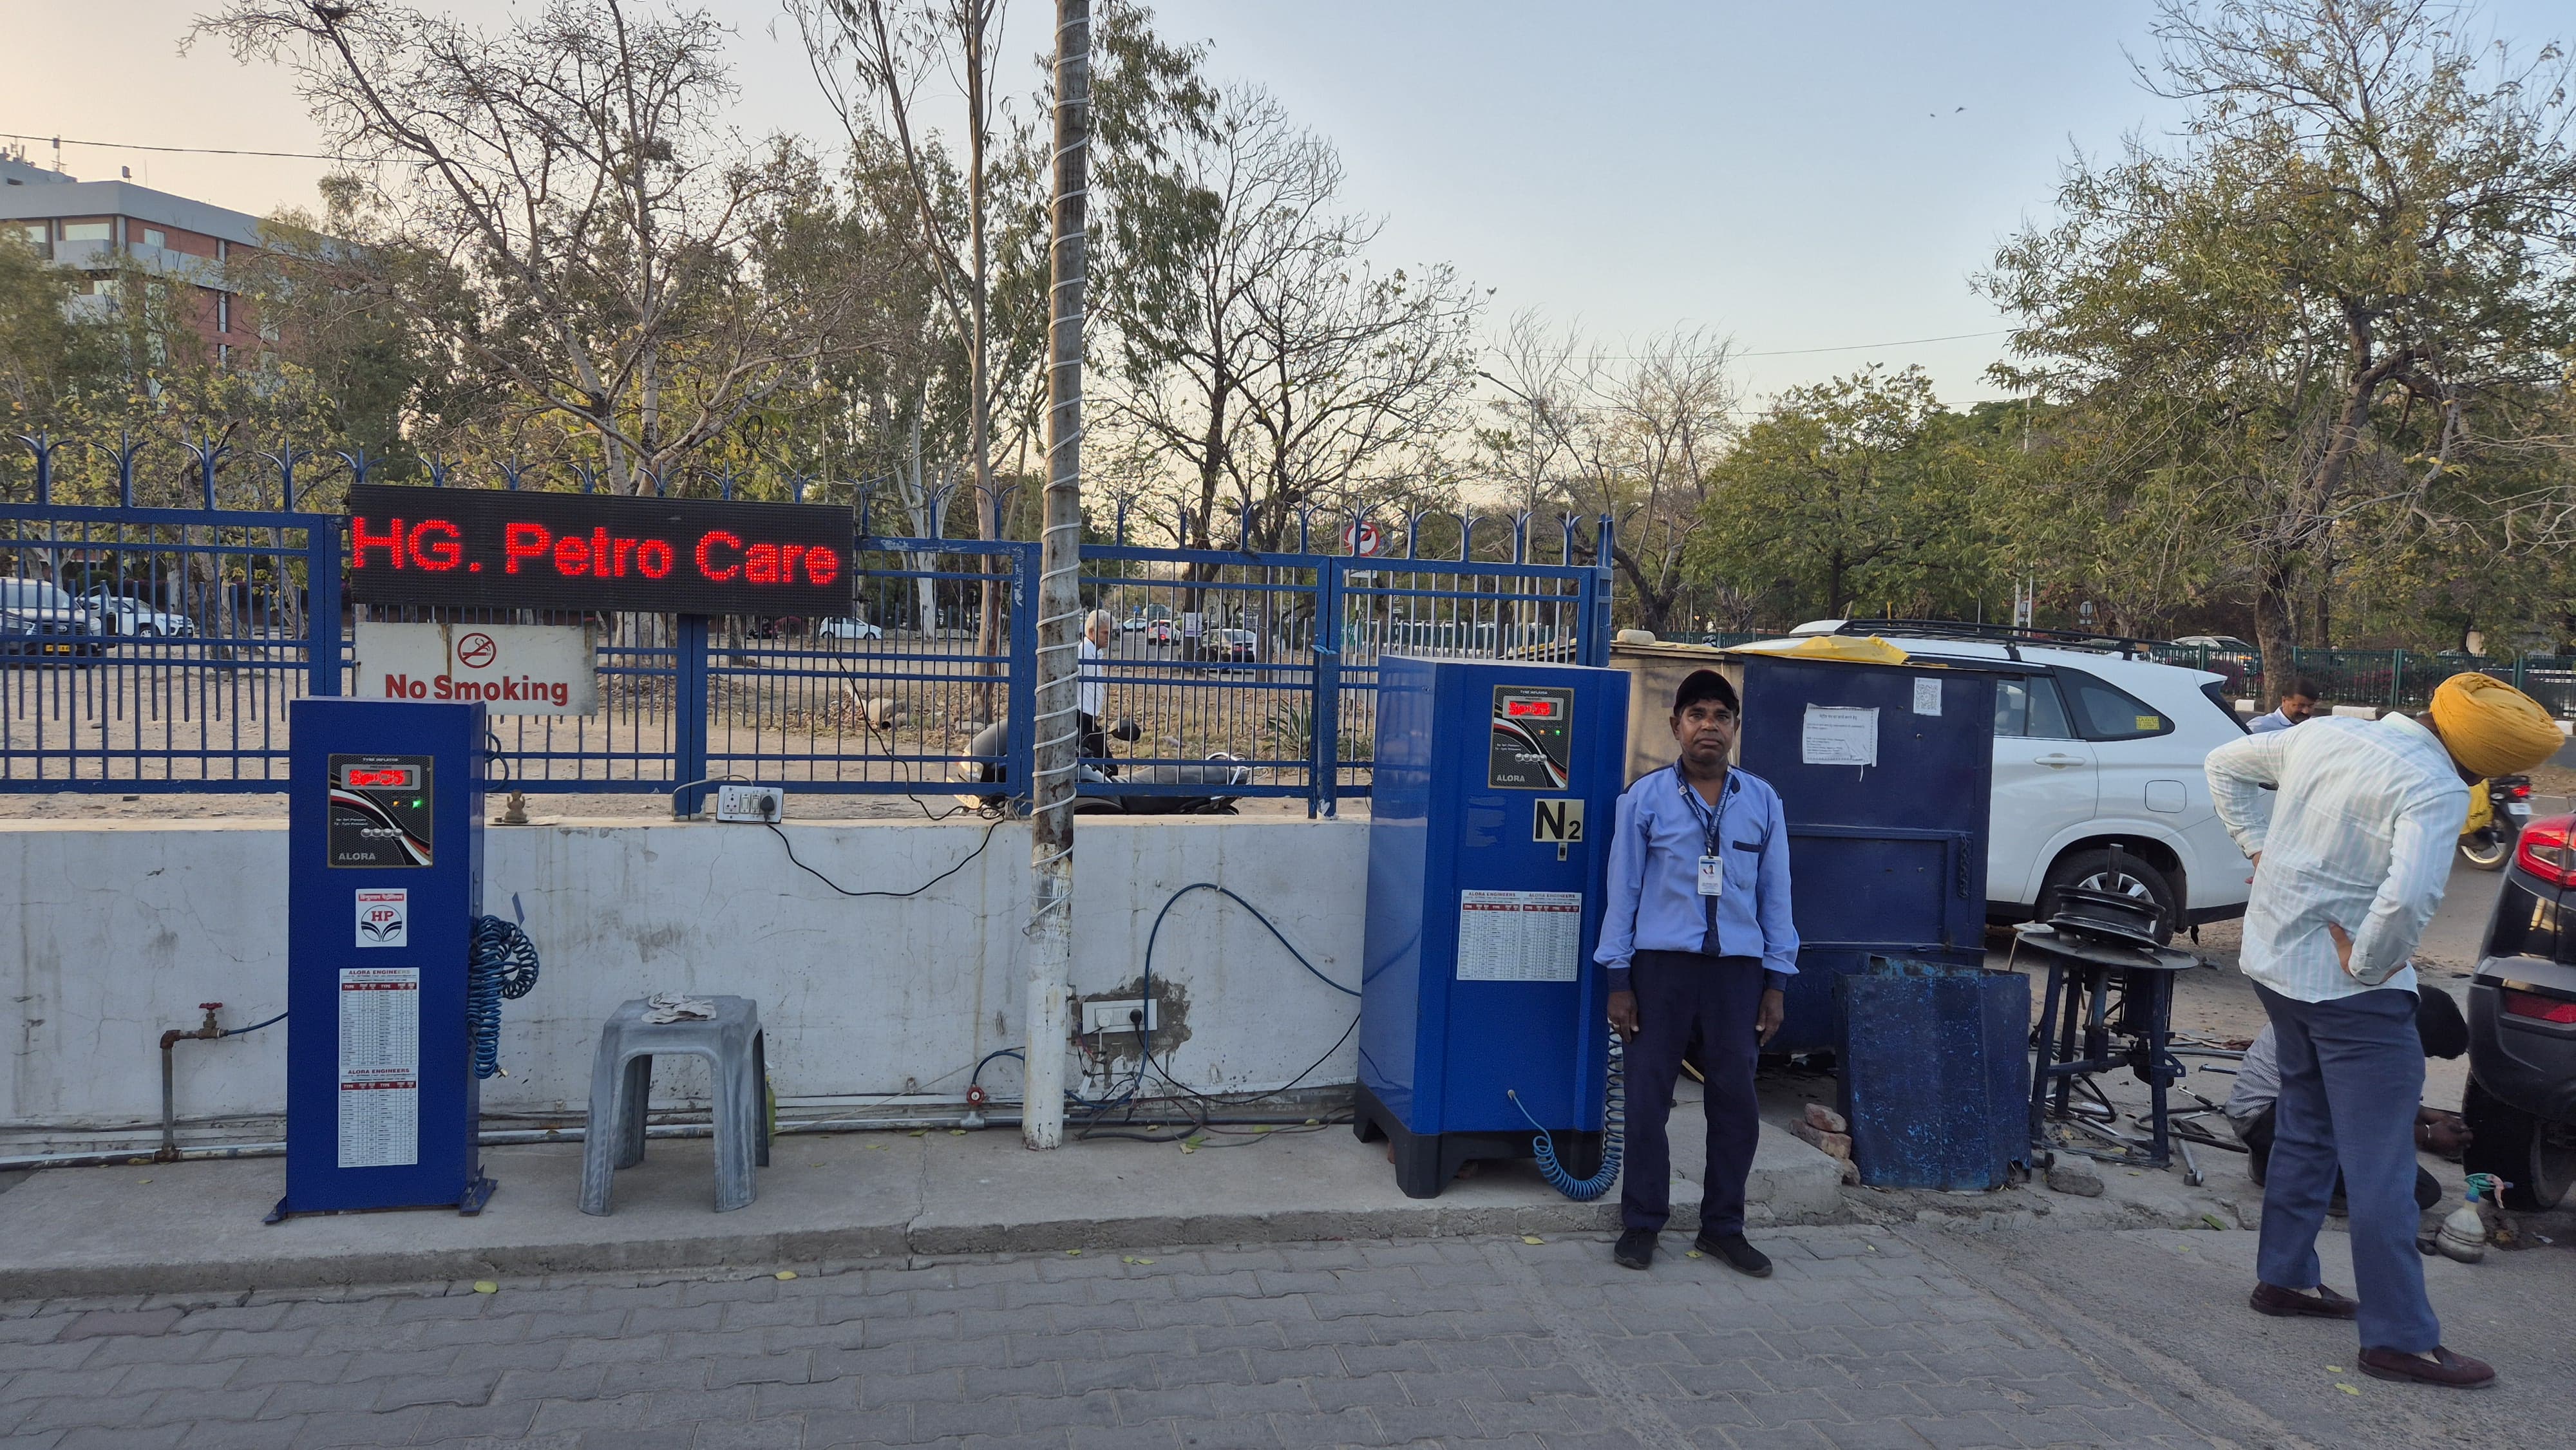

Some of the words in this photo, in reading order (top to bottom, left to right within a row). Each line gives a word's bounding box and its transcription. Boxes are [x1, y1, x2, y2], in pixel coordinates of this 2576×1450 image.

[352, 516, 481, 570] HG.
[504, 522, 674, 579] Petro
[695, 531, 839, 585] Care
[385, 674, 427, 699] No
[433, 675, 568, 706] Smoking
[371, 910, 394, 921] HP
